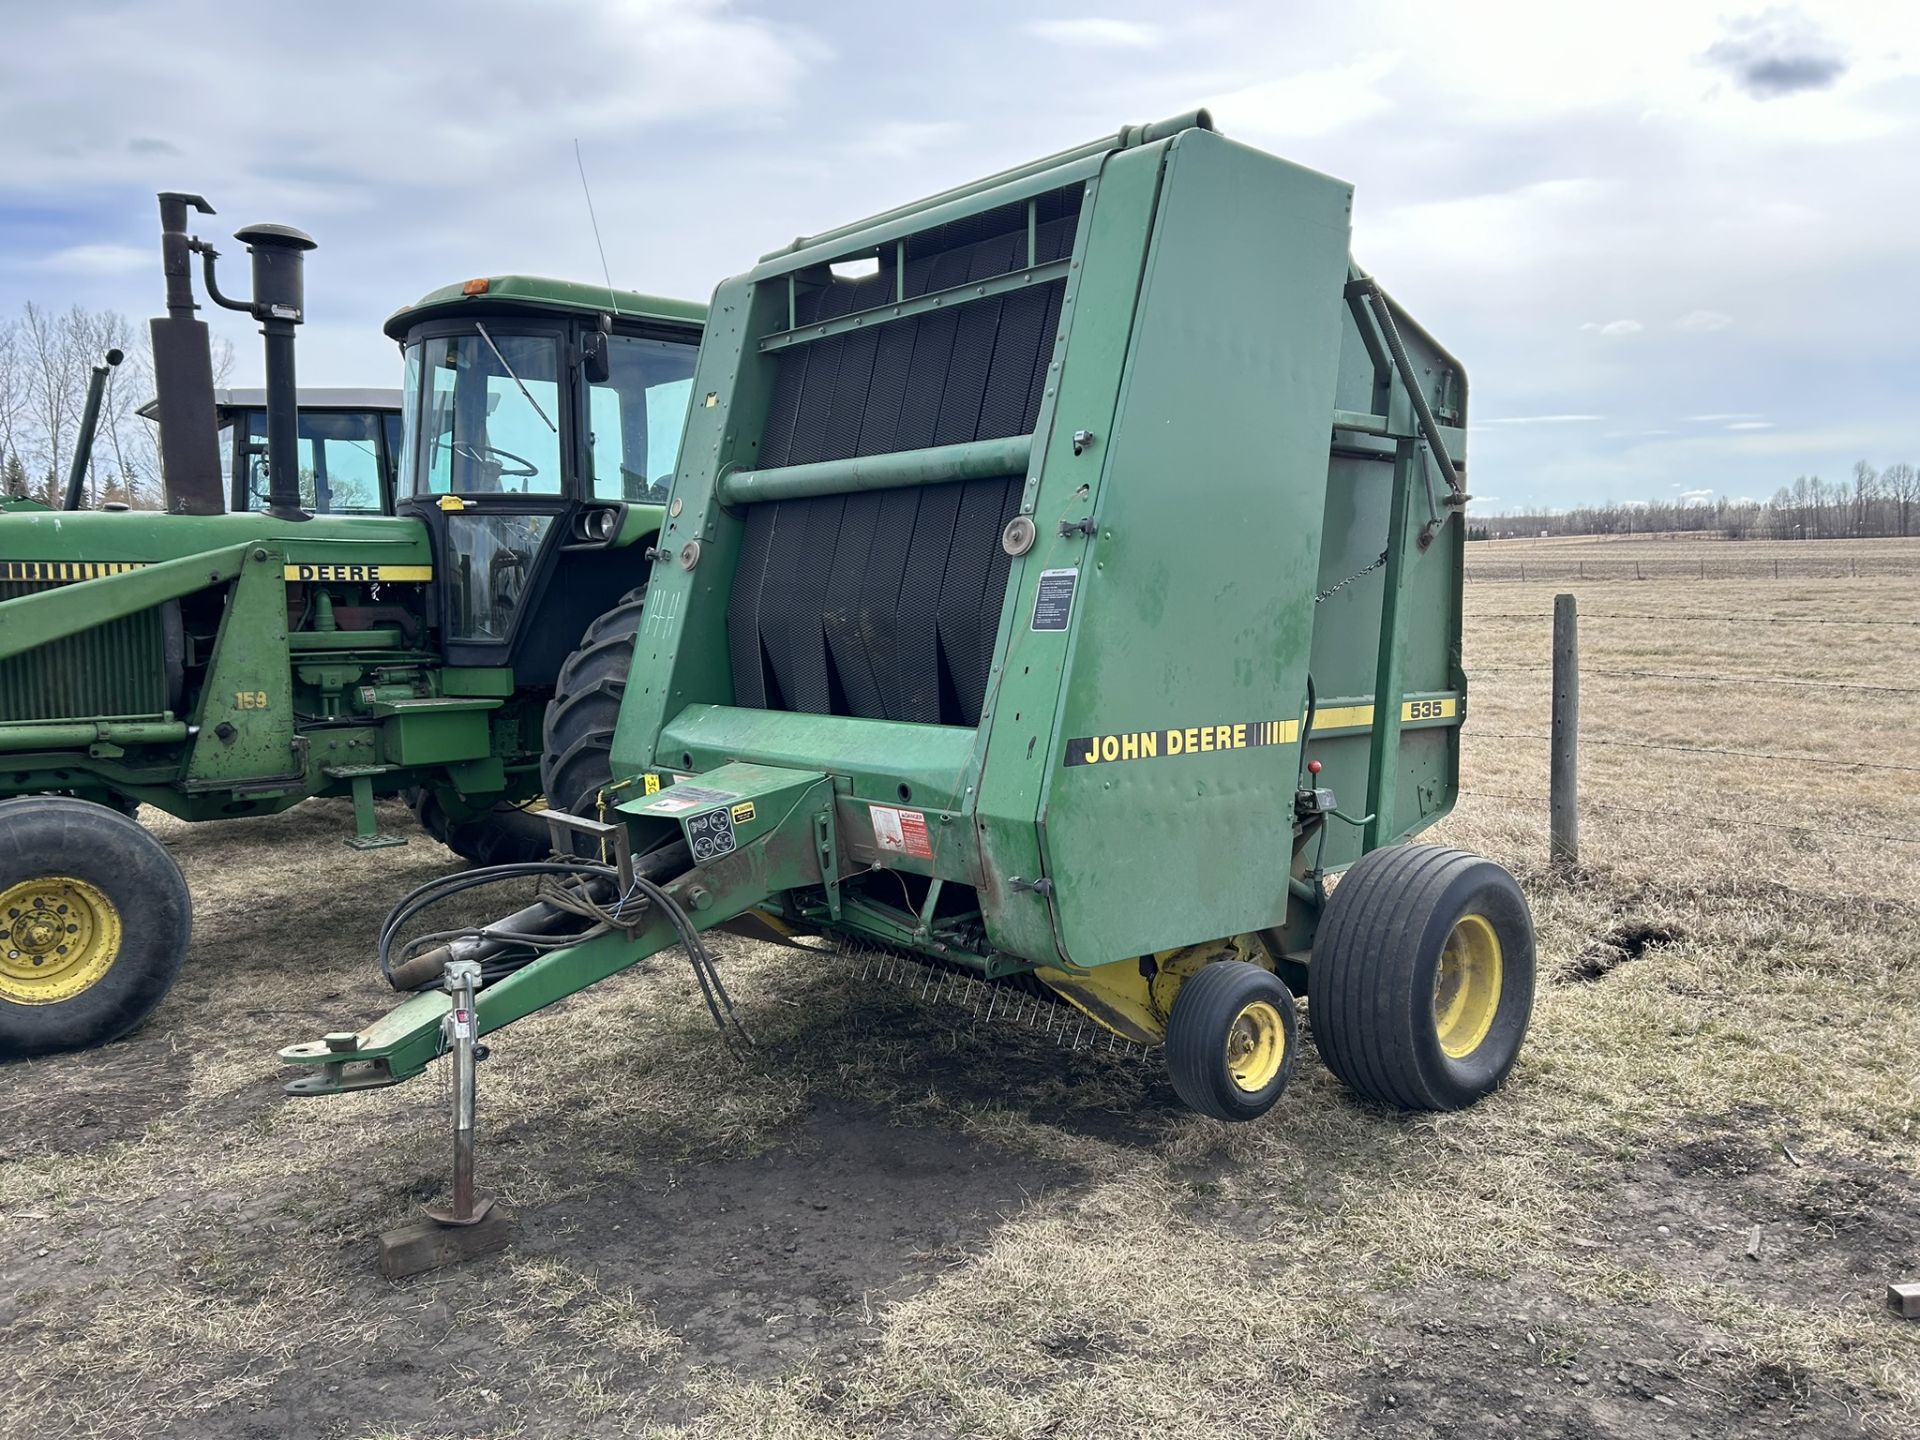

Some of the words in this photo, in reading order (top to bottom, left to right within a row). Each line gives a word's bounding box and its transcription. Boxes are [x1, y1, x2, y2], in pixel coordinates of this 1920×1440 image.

[300, 565, 380, 581] DEERE
[235, 691, 267, 709] 159
[1411, 701, 1442, 719] 535
[1085, 732, 1157, 764] JOHN
[1167, 724, 1247, 756] DEERE
